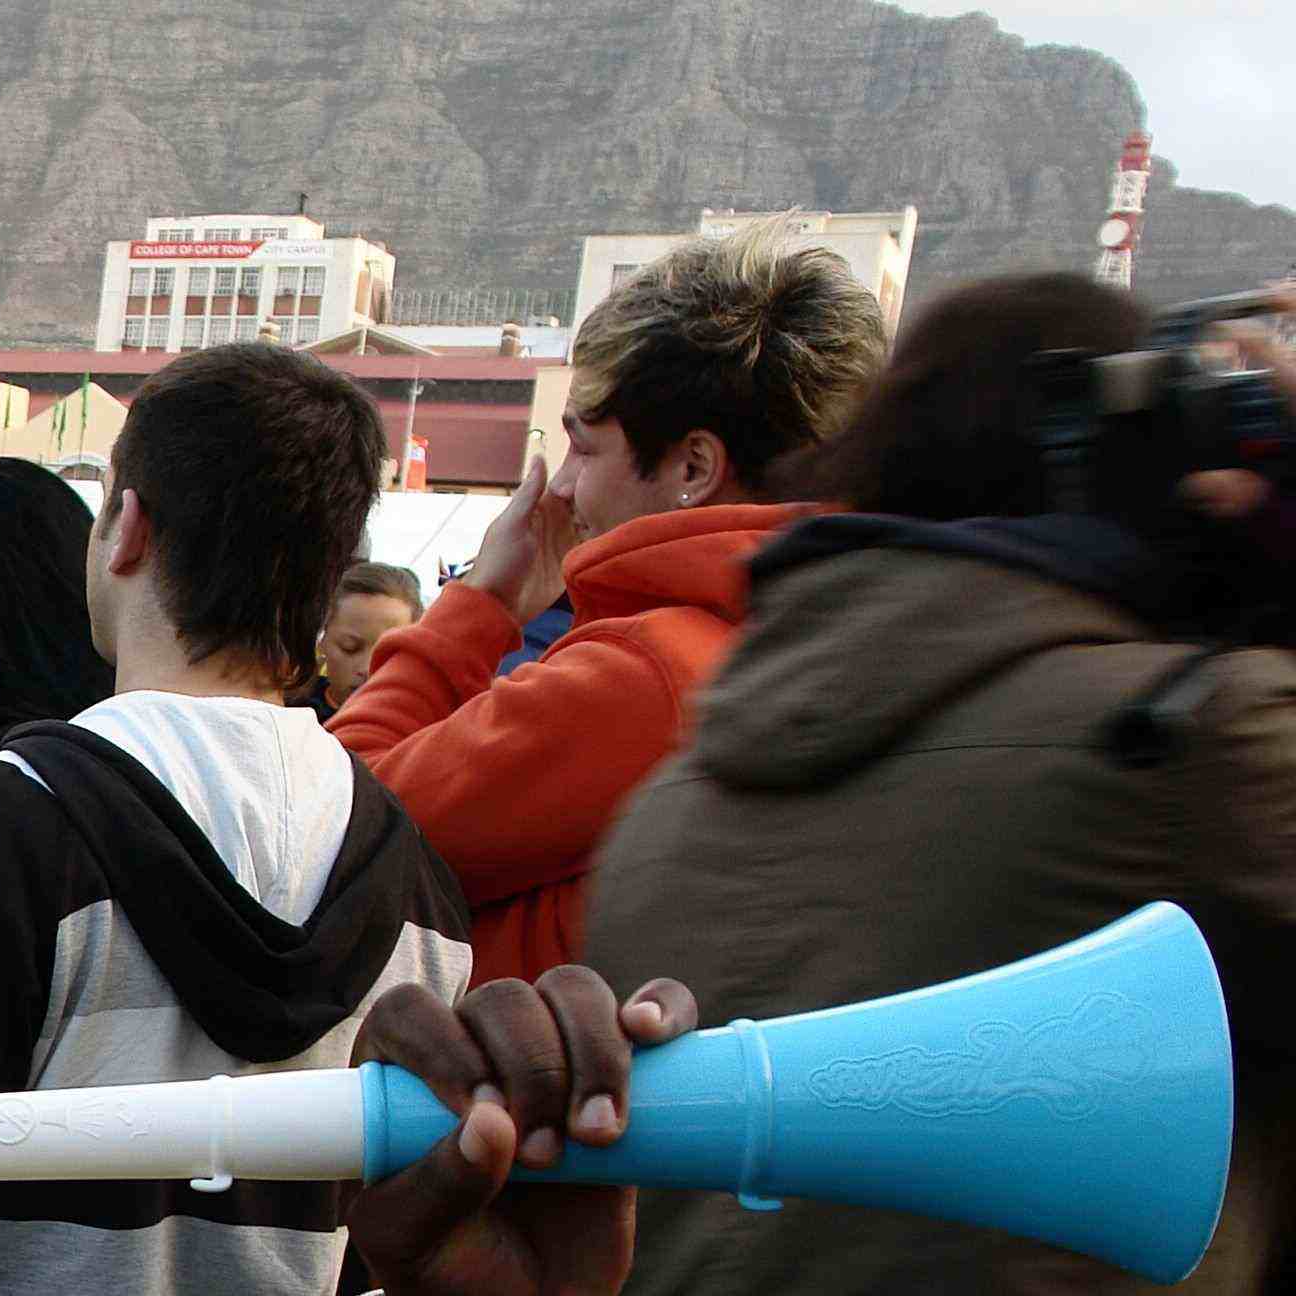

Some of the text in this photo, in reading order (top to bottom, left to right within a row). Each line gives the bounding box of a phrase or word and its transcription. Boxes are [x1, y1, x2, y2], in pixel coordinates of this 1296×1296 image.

[135, 244, 177, 257] COLLEGE
[179, 244, 195, 257] OF
[195, 244, 221, 257] CAPE
